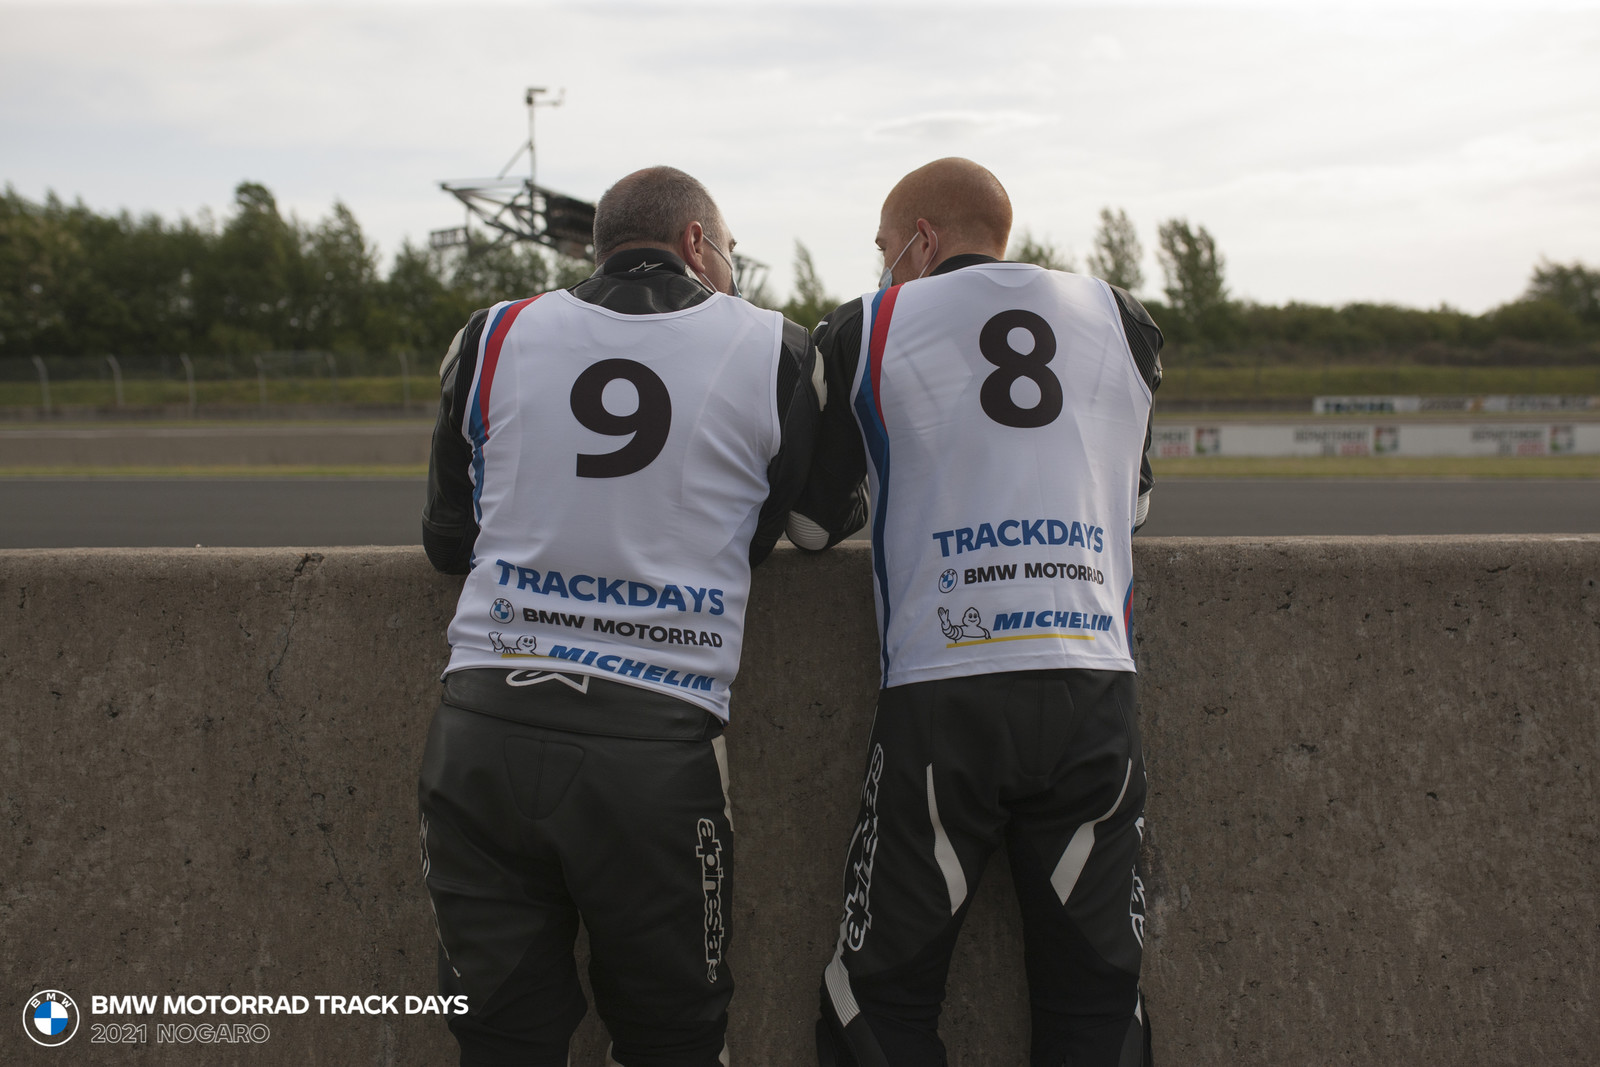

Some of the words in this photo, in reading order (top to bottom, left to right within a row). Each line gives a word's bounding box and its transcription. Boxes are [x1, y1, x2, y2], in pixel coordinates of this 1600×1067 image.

[979, 309, 1063, 428] 8
[570, 358, 672, 479] 9
[932, 519, 1104, 558] TRACKDAYS
[496, 559, 725, 615] TRACKDAYS
[964, 564, 1017, 585] BMW
[1024, 562, 1104, 585] MOTORRAD
[522, 607, 584, 629] BMW
[593, 618, 723, 648] MOTORRAD
[993, 610, 1113, 632] MICHELIN
[548, 645, 716, 691] MICHELIN
